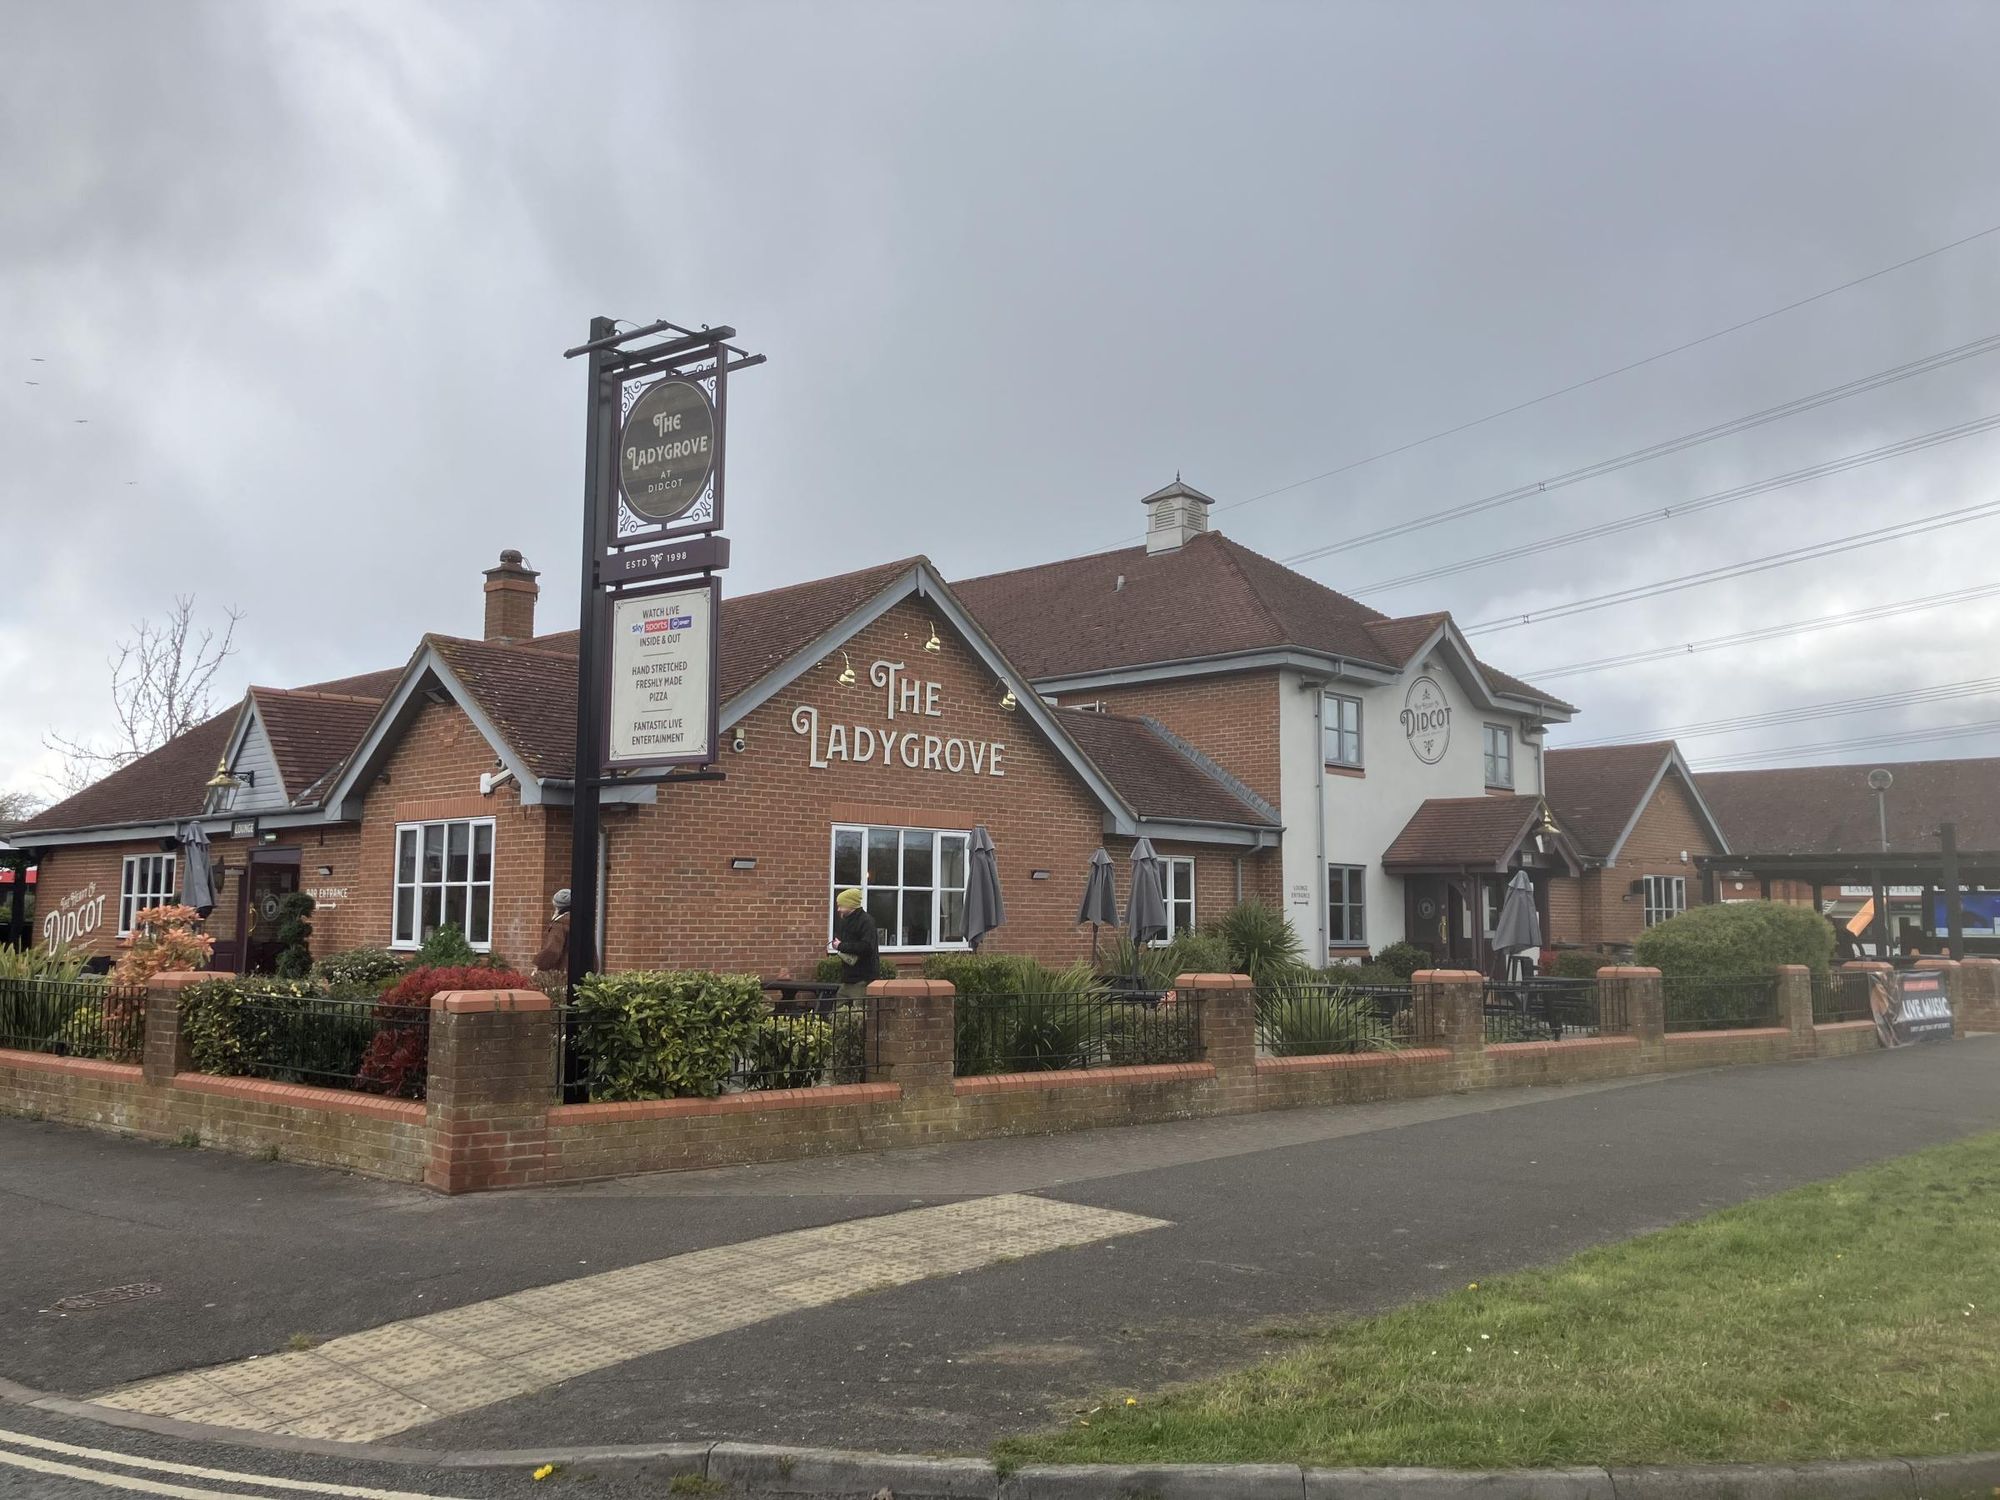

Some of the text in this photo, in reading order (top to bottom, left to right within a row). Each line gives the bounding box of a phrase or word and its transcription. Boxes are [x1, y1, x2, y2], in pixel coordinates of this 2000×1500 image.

[653, 412, 681, 437] THE
[627, 436, 707, 470] LADYGROVE
[660, 470, 671, 479] AT
[648, 479, 682, 493] DIDCOT
[625, 552, 687, 569] ESTD 1998
[643, 605, 679, 618] WATCH LIVE
[632, 623, 643, 633] sky
[645, 621, 668, 631] sports
[640, 634, 680, 647] INSIDE & OUT
[632, 661, 687, 675] HAND STRETCHED
[636, 676, 682, 689] FRESHLY MADE
[649, 692, 668, 701] PIZZA
[870, 660, 942, 720] THE
[634, 719, 682, 731] FANTASTIC LIVE
[1400, 707, 1452, 739] DIDCOT
[632, 733, 684, 745] ENTERTAINMENT
[791, 705, 1005, 776] LADYGROVE
[234, 823, 254, 834] LOUNGE
[319, 888, 348, 898] ENTRANCE
[44, 894, 105, 957] DIDCOT
[1902, 996, 1952, 1020] LIVE MUSIC
